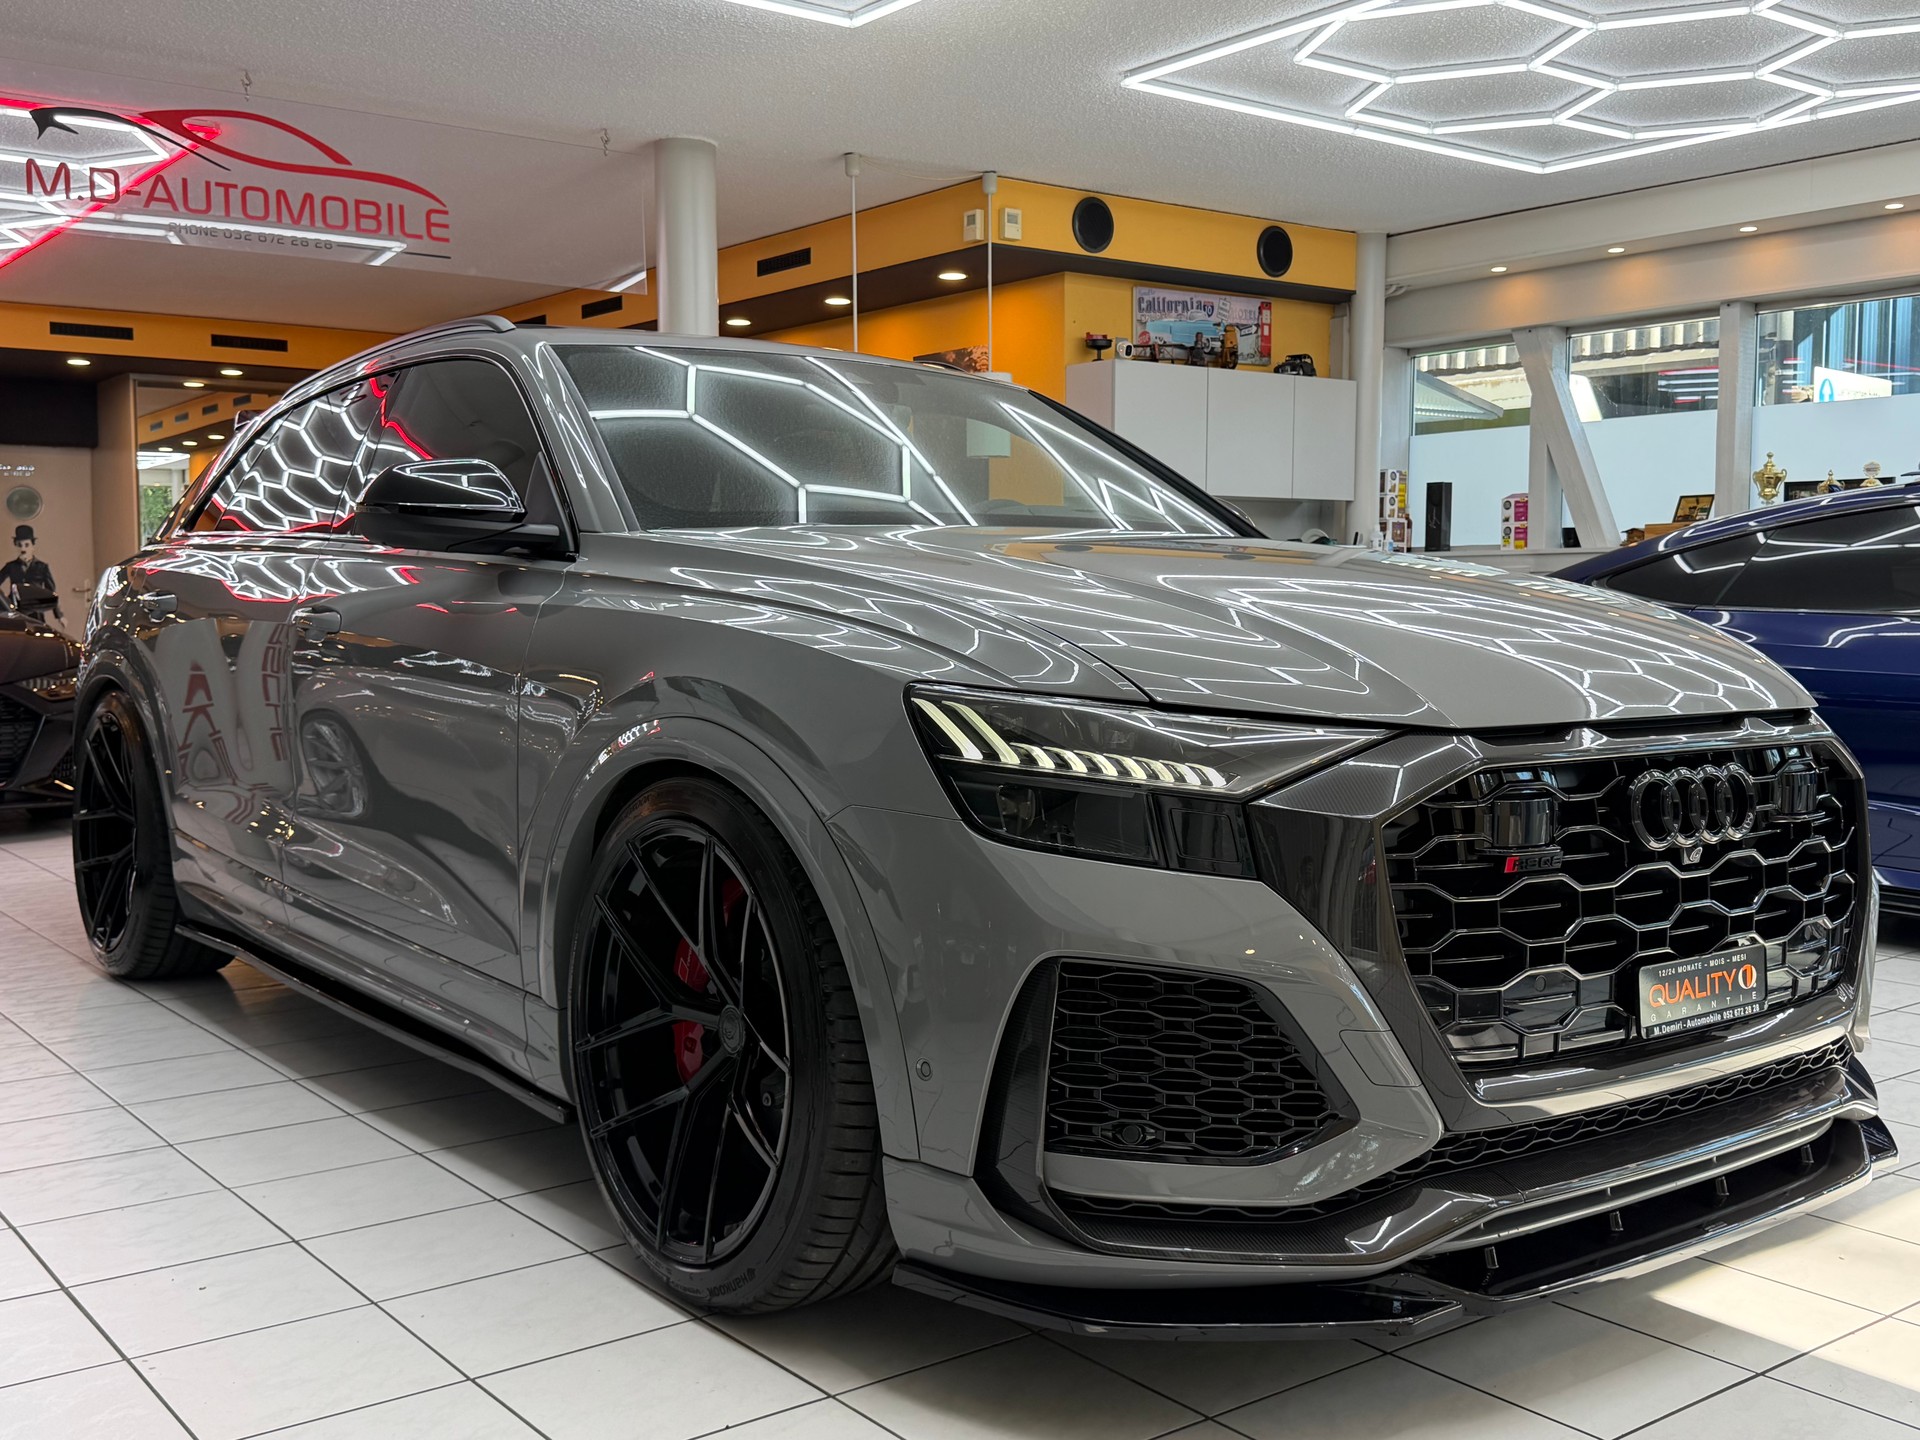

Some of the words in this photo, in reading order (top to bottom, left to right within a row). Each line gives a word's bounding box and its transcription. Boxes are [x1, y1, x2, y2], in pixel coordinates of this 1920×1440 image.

[25, 158, 452, 244] M.D-AUTOMOBILE
[168, 222, 218, 238] PHONE
[1138, 297, 1202, 313] California
[1658, 967, 1676, 978] 12/24
[1677, 962, 1702, 973] MONATE
[1709, 956, 1725, 967] MOIS
[1732, 953, 1747, 962] MESI
[1648, 968, 1737, 1008] QUALITY
[1650, 991, 1757, 1022] GARANTIE
[1723, 1010, 1734, 1020] 052
